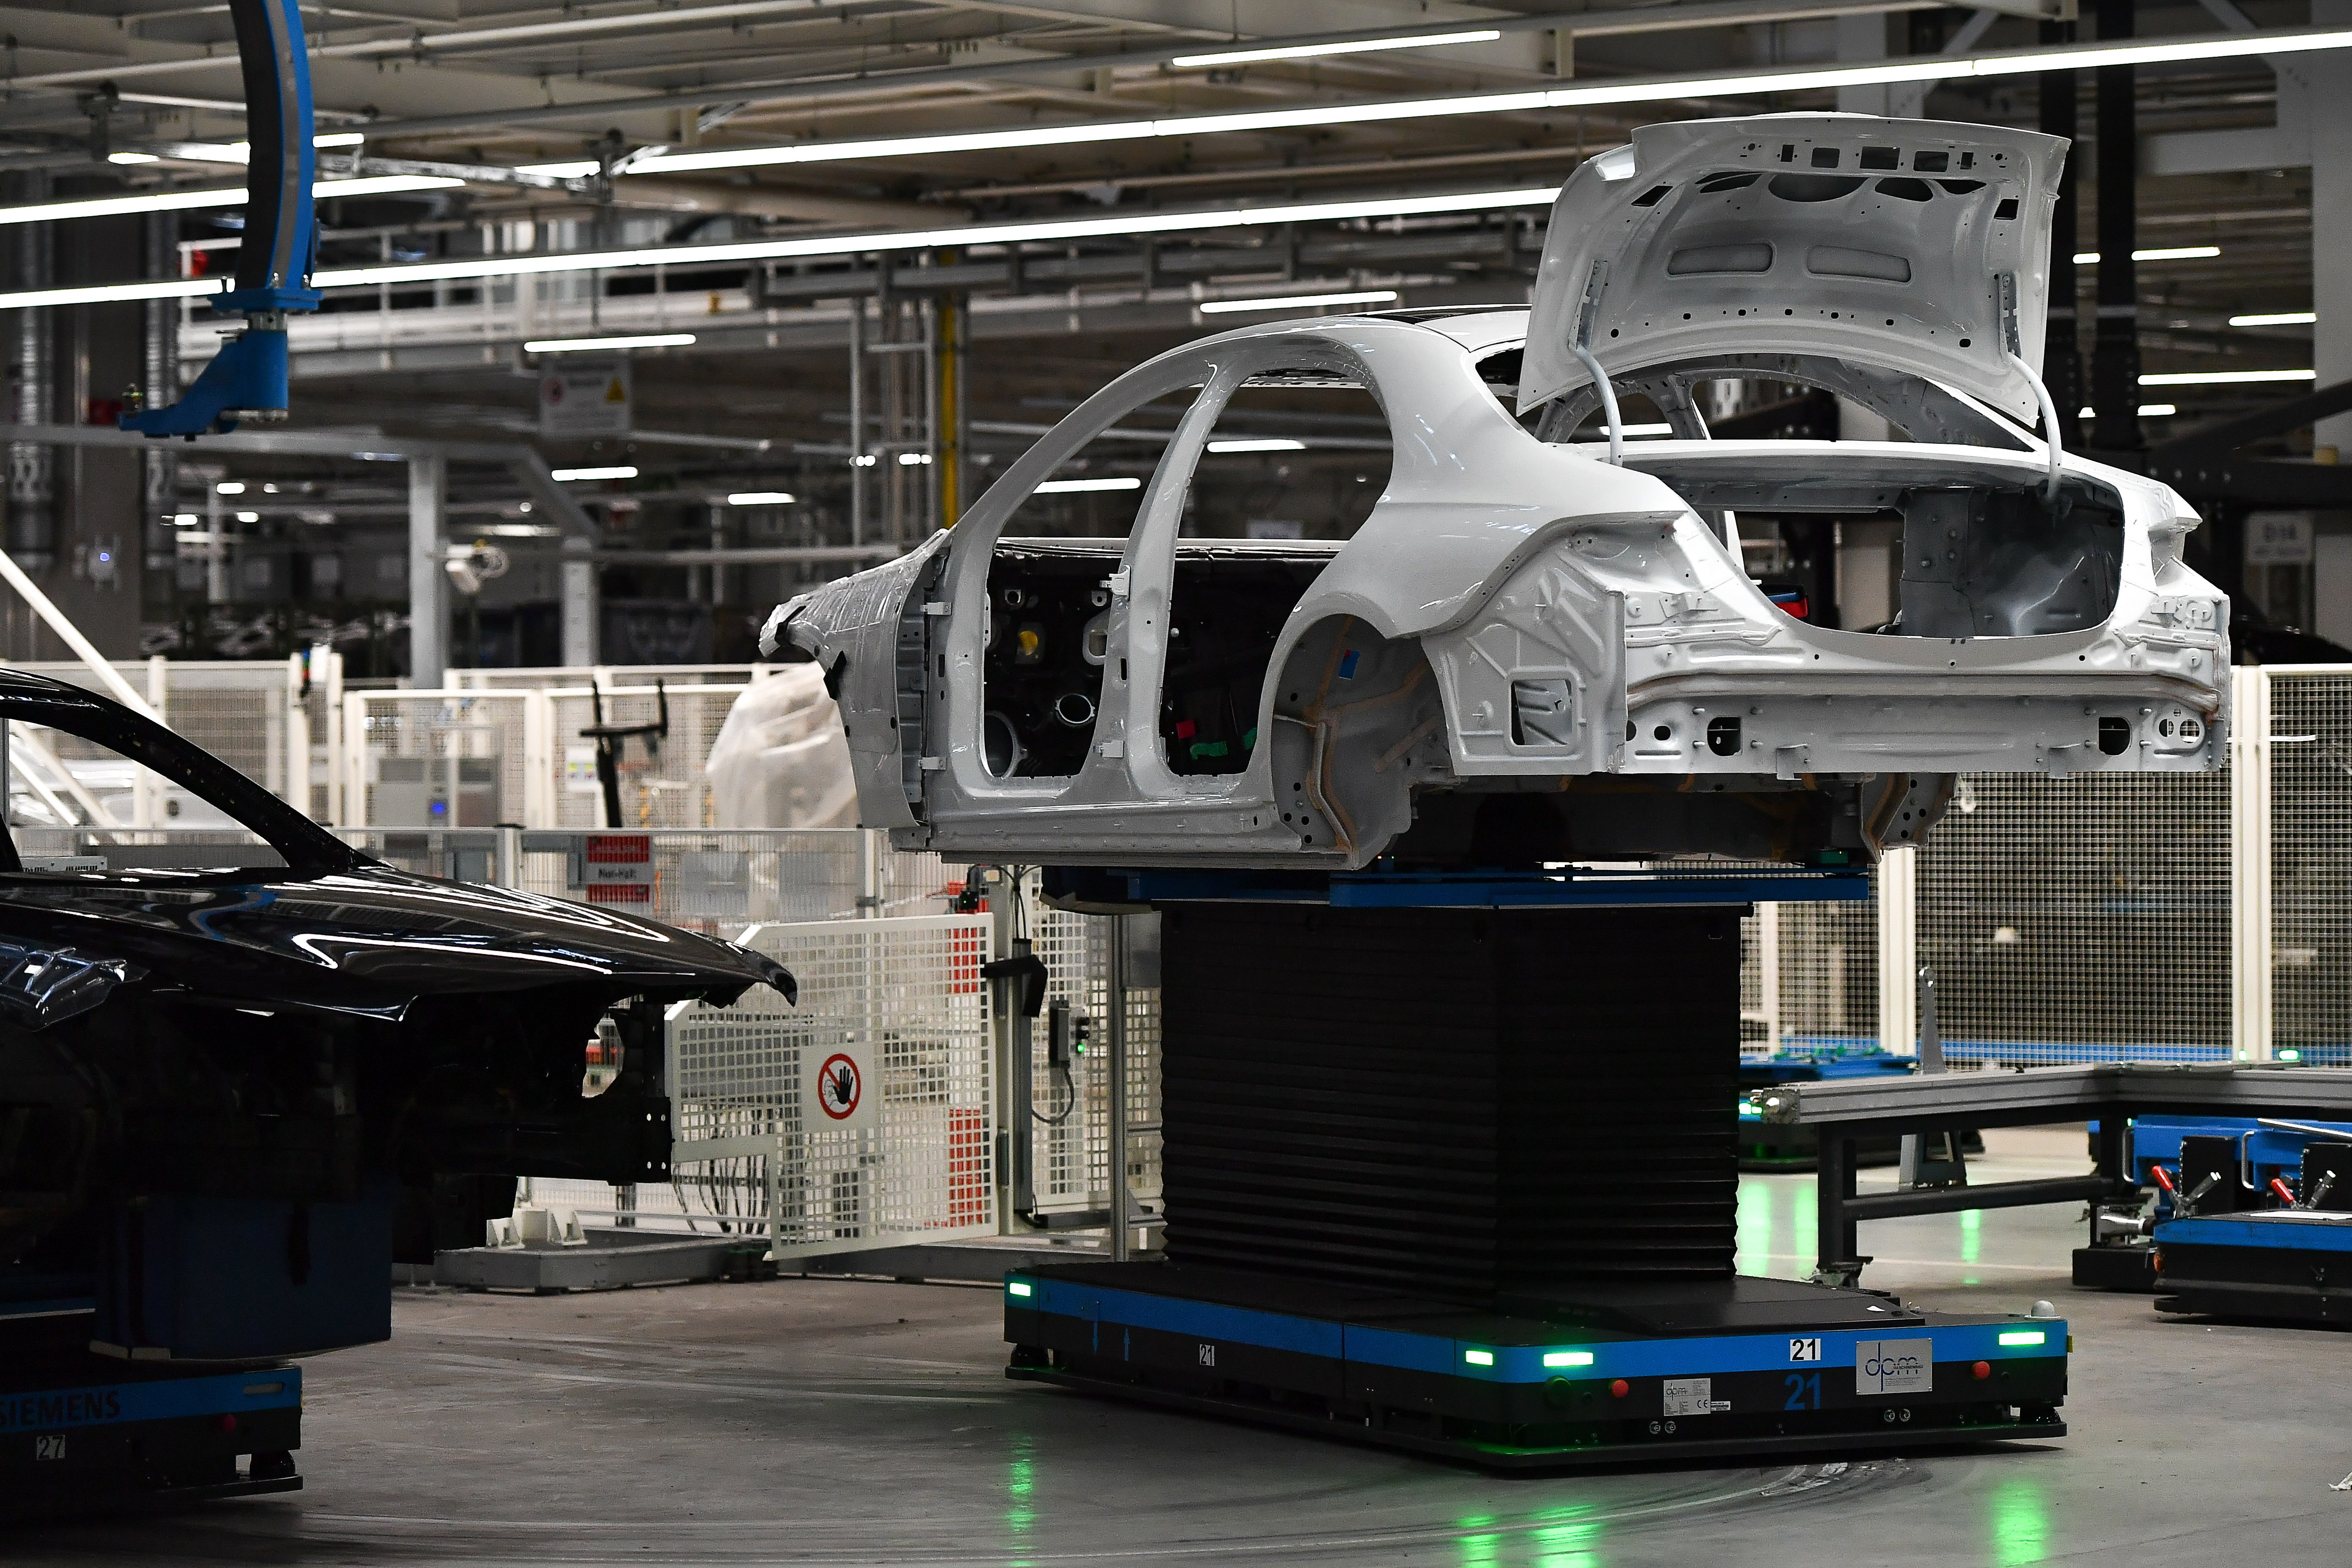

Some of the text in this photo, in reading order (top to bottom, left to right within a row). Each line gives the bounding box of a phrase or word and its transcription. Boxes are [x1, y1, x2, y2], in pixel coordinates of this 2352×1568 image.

[1201, 1345, 1212, 1366] 21
[1792, 1339, 1816, 1360] 21
[1866, 1342, 1918, 1392] dpm
[1784, 1372, 1821, 1411] 21
[39, 1435, 64, 1460] 27
